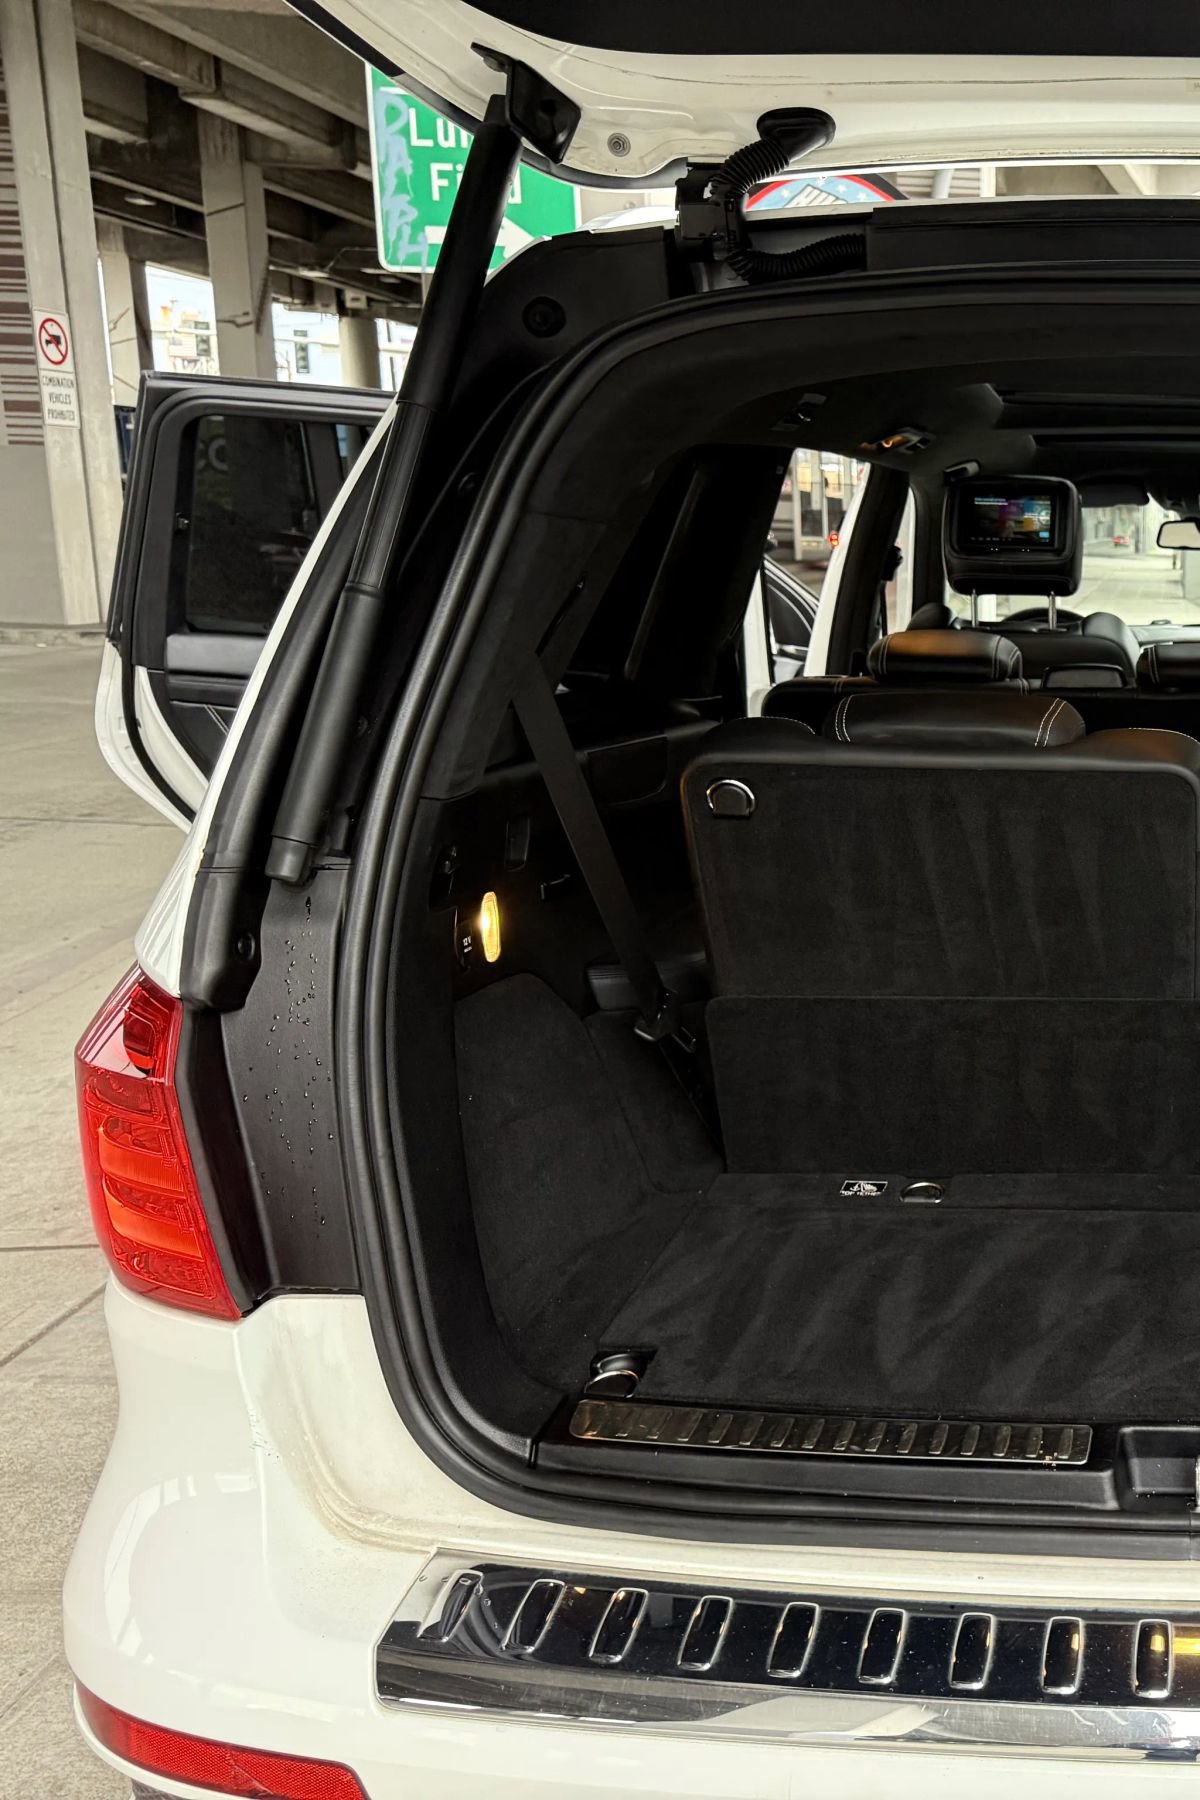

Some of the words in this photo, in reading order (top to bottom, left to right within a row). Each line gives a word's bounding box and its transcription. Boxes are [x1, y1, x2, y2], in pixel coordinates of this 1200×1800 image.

[42, 375, 74, 388] COMBINATION
[48, 391, 72, 405] VEHICLES
[47, 408, 76, 421] PROHIBITED
